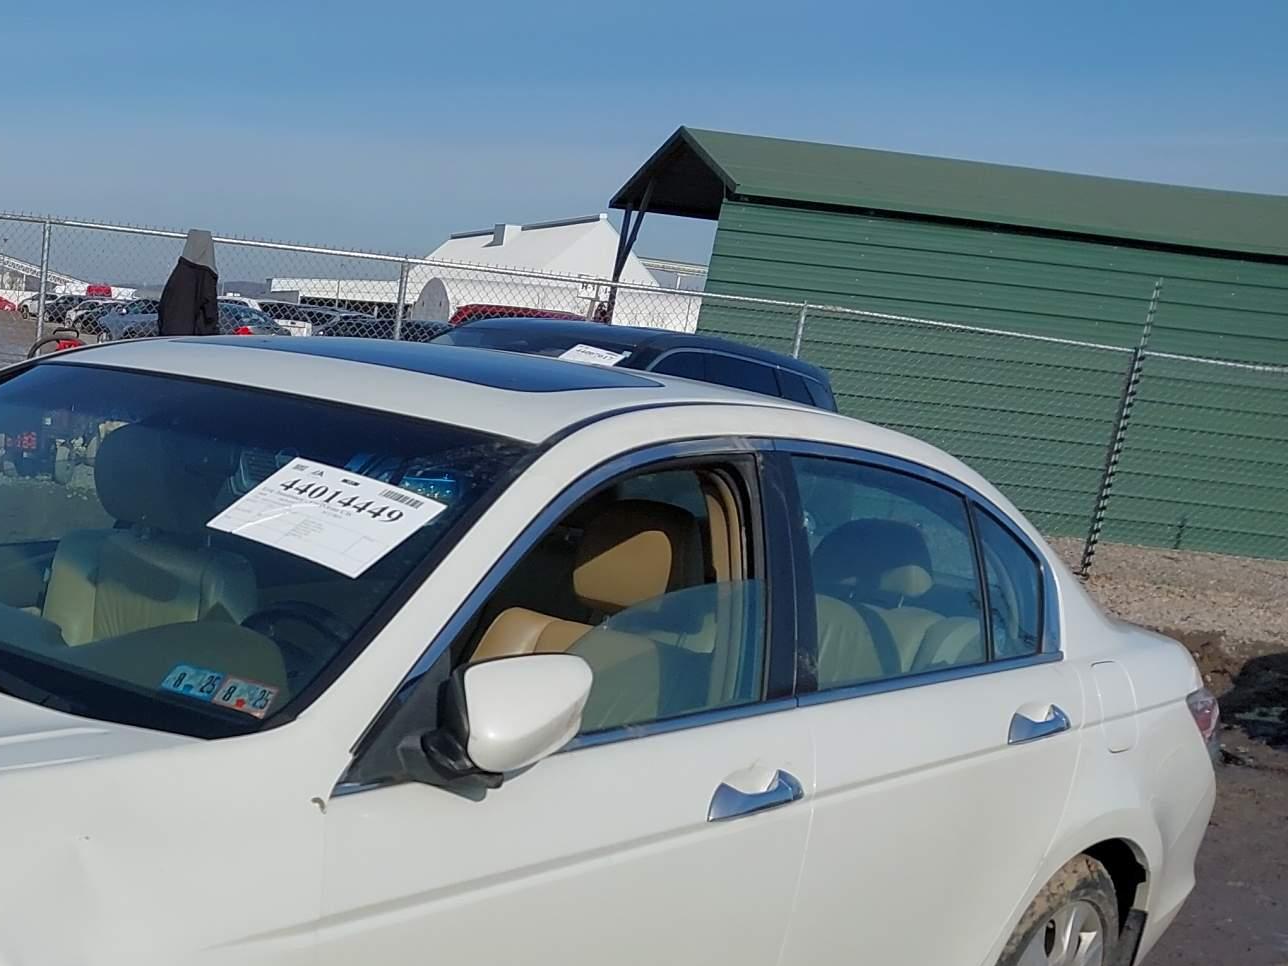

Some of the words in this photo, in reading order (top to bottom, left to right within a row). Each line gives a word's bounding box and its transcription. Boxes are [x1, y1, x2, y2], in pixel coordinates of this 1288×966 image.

[280, 478, 404, 523] 44014449
[173, 672, 187, 688] 8
[200, 675, 221, 694] 25
[222, 685, 237, 702] 8
[252, 689, 272, 710] 25
